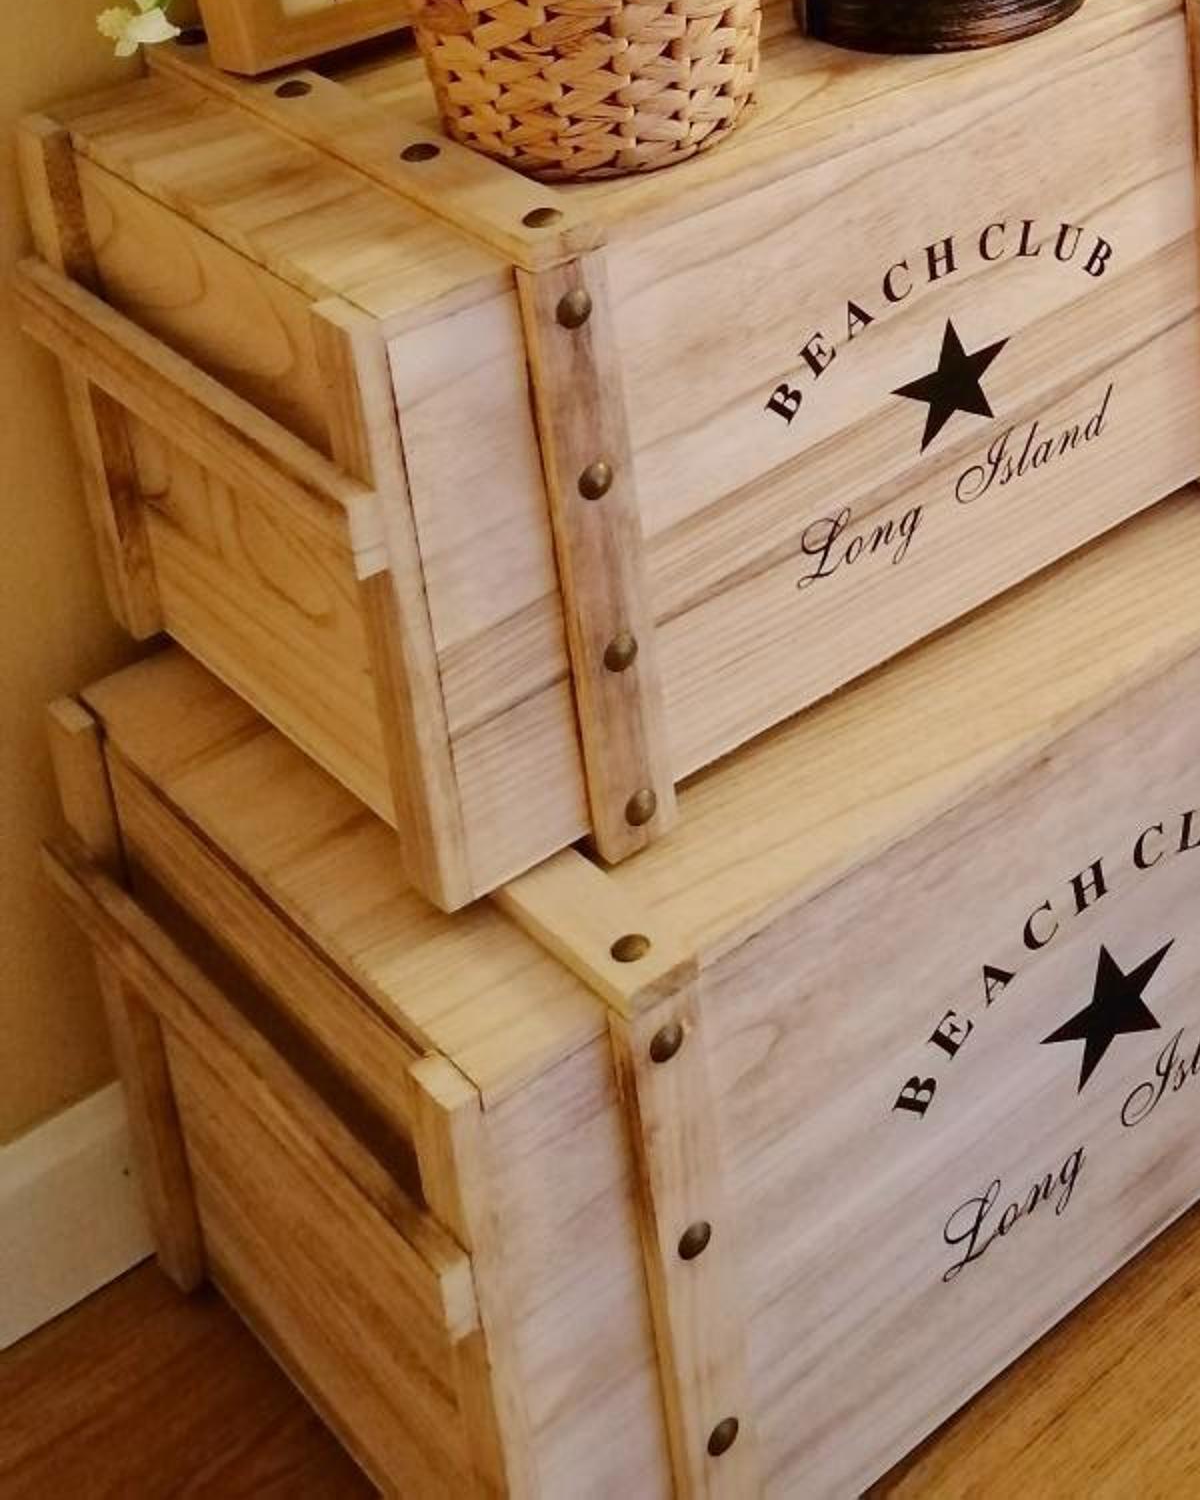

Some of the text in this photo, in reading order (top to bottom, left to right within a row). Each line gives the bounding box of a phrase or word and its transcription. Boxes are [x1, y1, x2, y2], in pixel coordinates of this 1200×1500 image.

[796, 383, 1113, 589] Long Island
[942, 1146, 1086, 1283] Long
